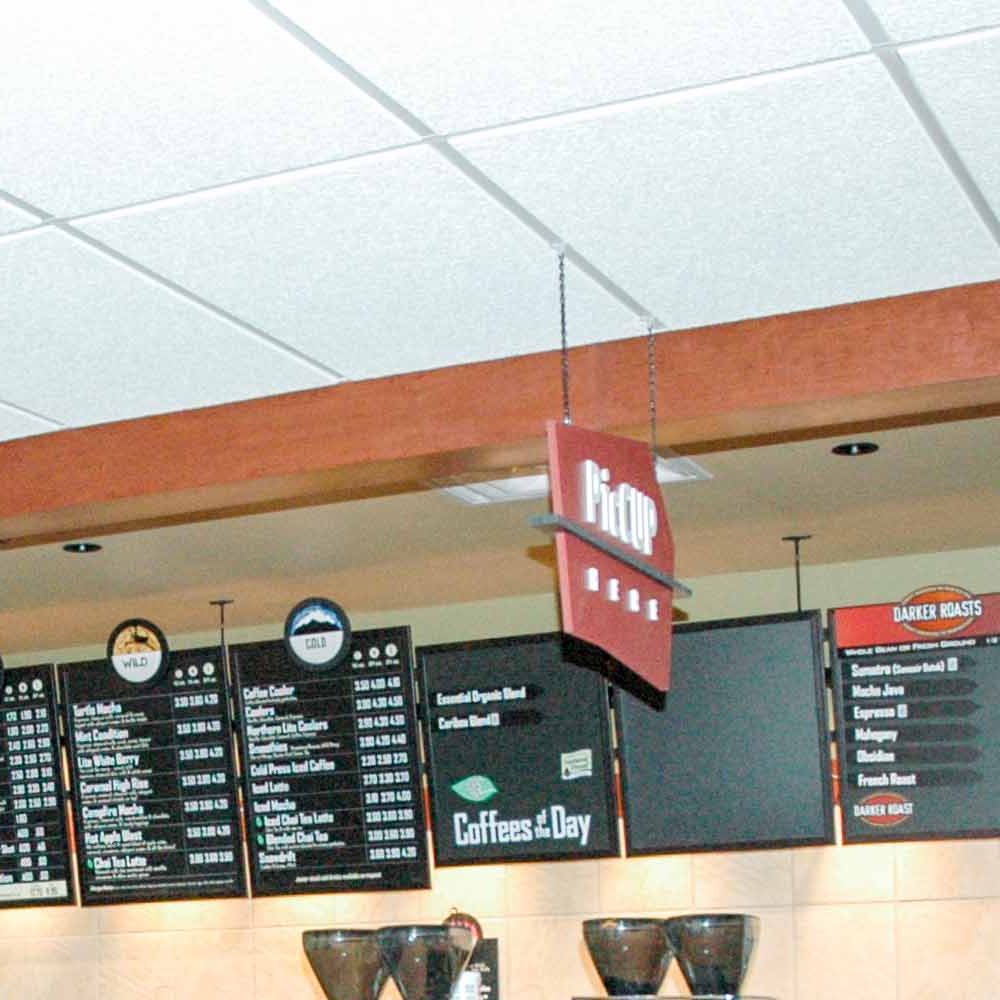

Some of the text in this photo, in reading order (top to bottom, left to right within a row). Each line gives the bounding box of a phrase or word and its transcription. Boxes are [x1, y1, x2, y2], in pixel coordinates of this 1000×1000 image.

[893, 599, 983, 623] DARKER ROASTS
[122, 656, 148, 669] WILD
[851, 663, 891, 677] Sumatra
[243, 687, 269, 700] Coffee
[269, 684, 296, 698] Cooler
[437, 685, 526, 706] Essential Organic Blend
[852, 683, 905, 698] Mocha Java
[245, 705, 275, 719] Coolers
[853, 705, 895, 720] Espresso
[247, 719, 329, 737] Northern Lite Coolers
[855, 727, 898, 742] Mahogany
[92, 754, 115, 767] White
[115, 752, 140, 766] Berry
[250, 764, 268, 777] Cold
[309, 759, 335, 772] Coffee
[857, 771, 917, 787] French Roast
[252, 781, 290, 795] Iced Latte
[254, 799, 296, 813] Iced Mocha
[854, 802, 913, 817] DARKER ROAST
[264, 815, 281, 827] Iced
[281, 813, 298, 826] Chai
[299, 812, 313, 825] Tea
[454, 805, 591, 846] Coffees of the Day
[265, 829, 329, 845] Blended Chai Tea
[111, 855, 125, 868] Tea
